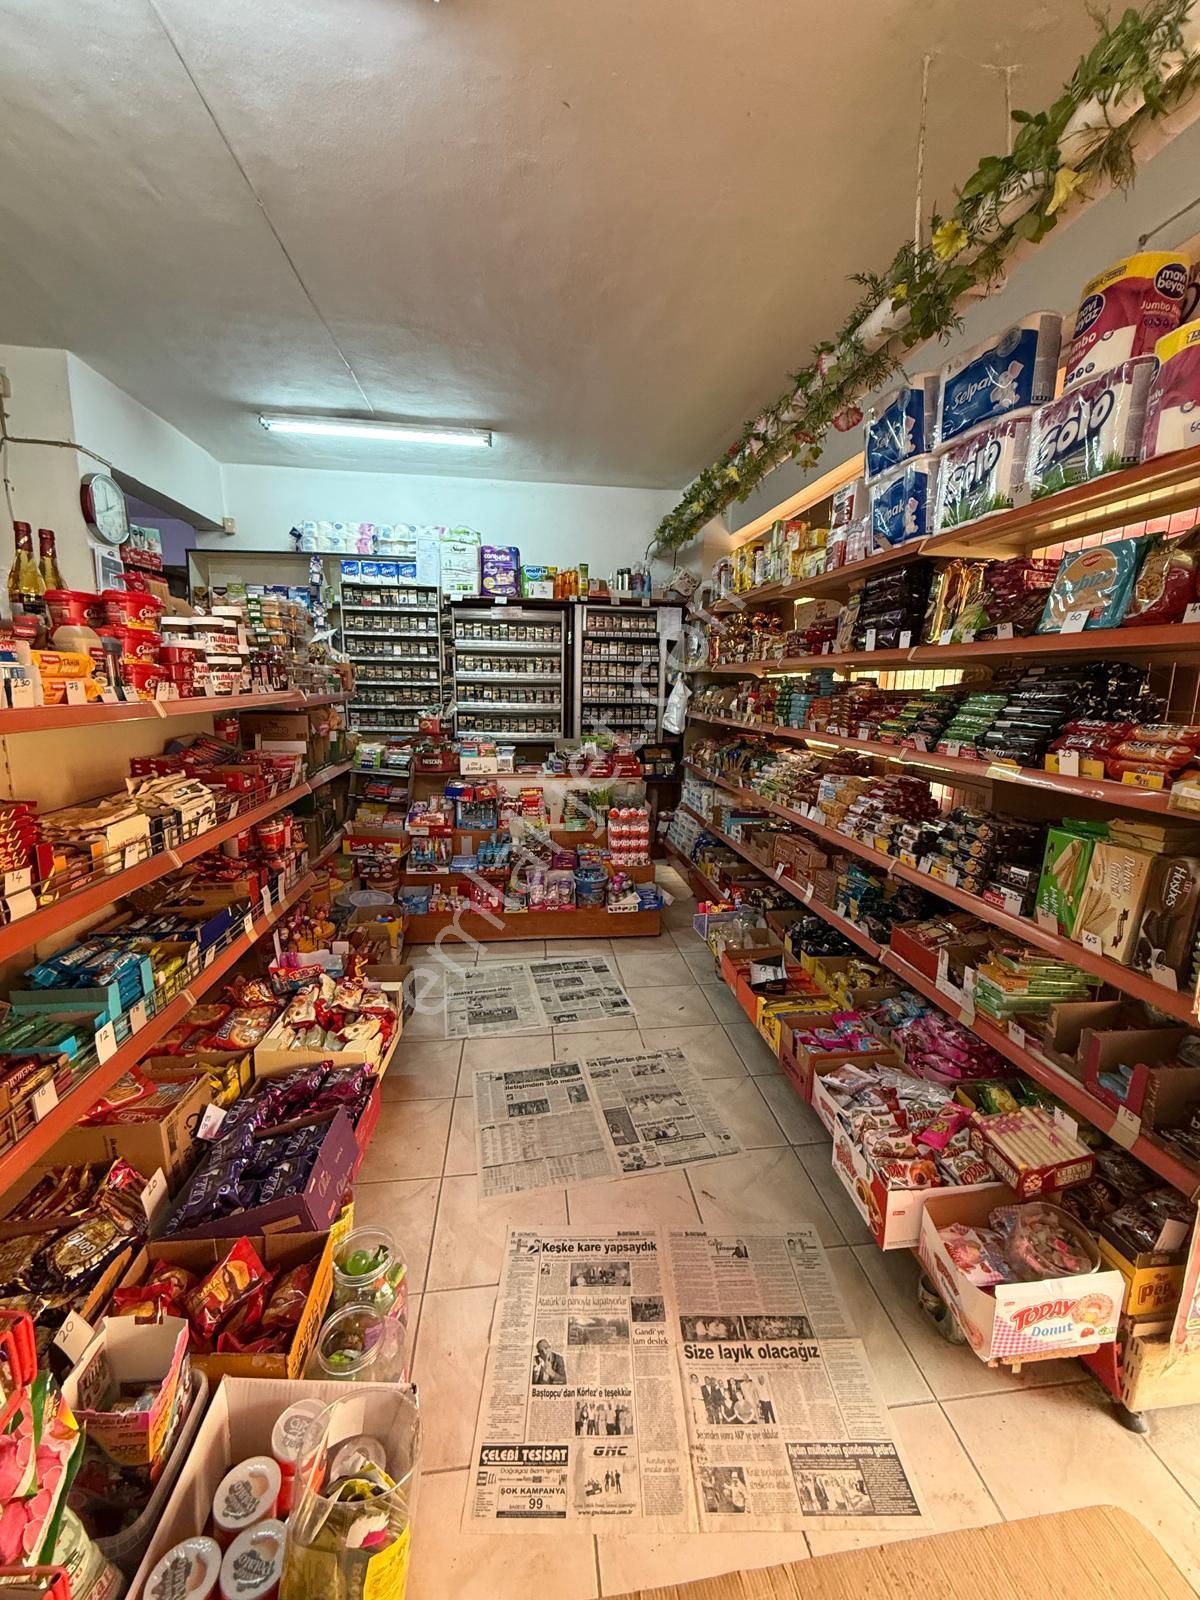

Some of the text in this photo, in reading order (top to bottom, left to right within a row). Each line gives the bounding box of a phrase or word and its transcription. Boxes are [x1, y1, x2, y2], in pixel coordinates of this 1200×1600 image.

[1162, 269, 1186, 282] mavi
[1157, 276, 1186, 295] beyaz
[1140, 300, 1171, 312] Jumbo
[483, 552, 511, 562] canbebe
[525, 567, 548, 575] molfix
[1070, 612, 1083, 622] 60
[13, 680, 31, 689] 230
[1062, 749, 1073, 758] 25
[1122, 855, 1136, 896] Deluxe
[1167, 865, 1188, 908] Hosbes
[1084, 933, 1097, 944] 45
[99, 1031, 110, 1042] 12
[541, 1241, 658, 1255] Keşke kare yapsaydık
[1010, 1298, 1080, 1334] TODAY
[59, 1319, 77, 1344] 20
[1030, 1321, 1074, 1338] Donut
[632, 1336, 669, 1346] tam destek
[684, 1343, 820, 1363] Size layık olacağız
[603, 1387, 632, 1400] teşekkür
[481, 1446, 568, 1464] ÇELEBİ TESİSAT
[500, 1487, 566, 1496] ŞOK KAMPANYA
[528, 1497, 543, 1510] 99
